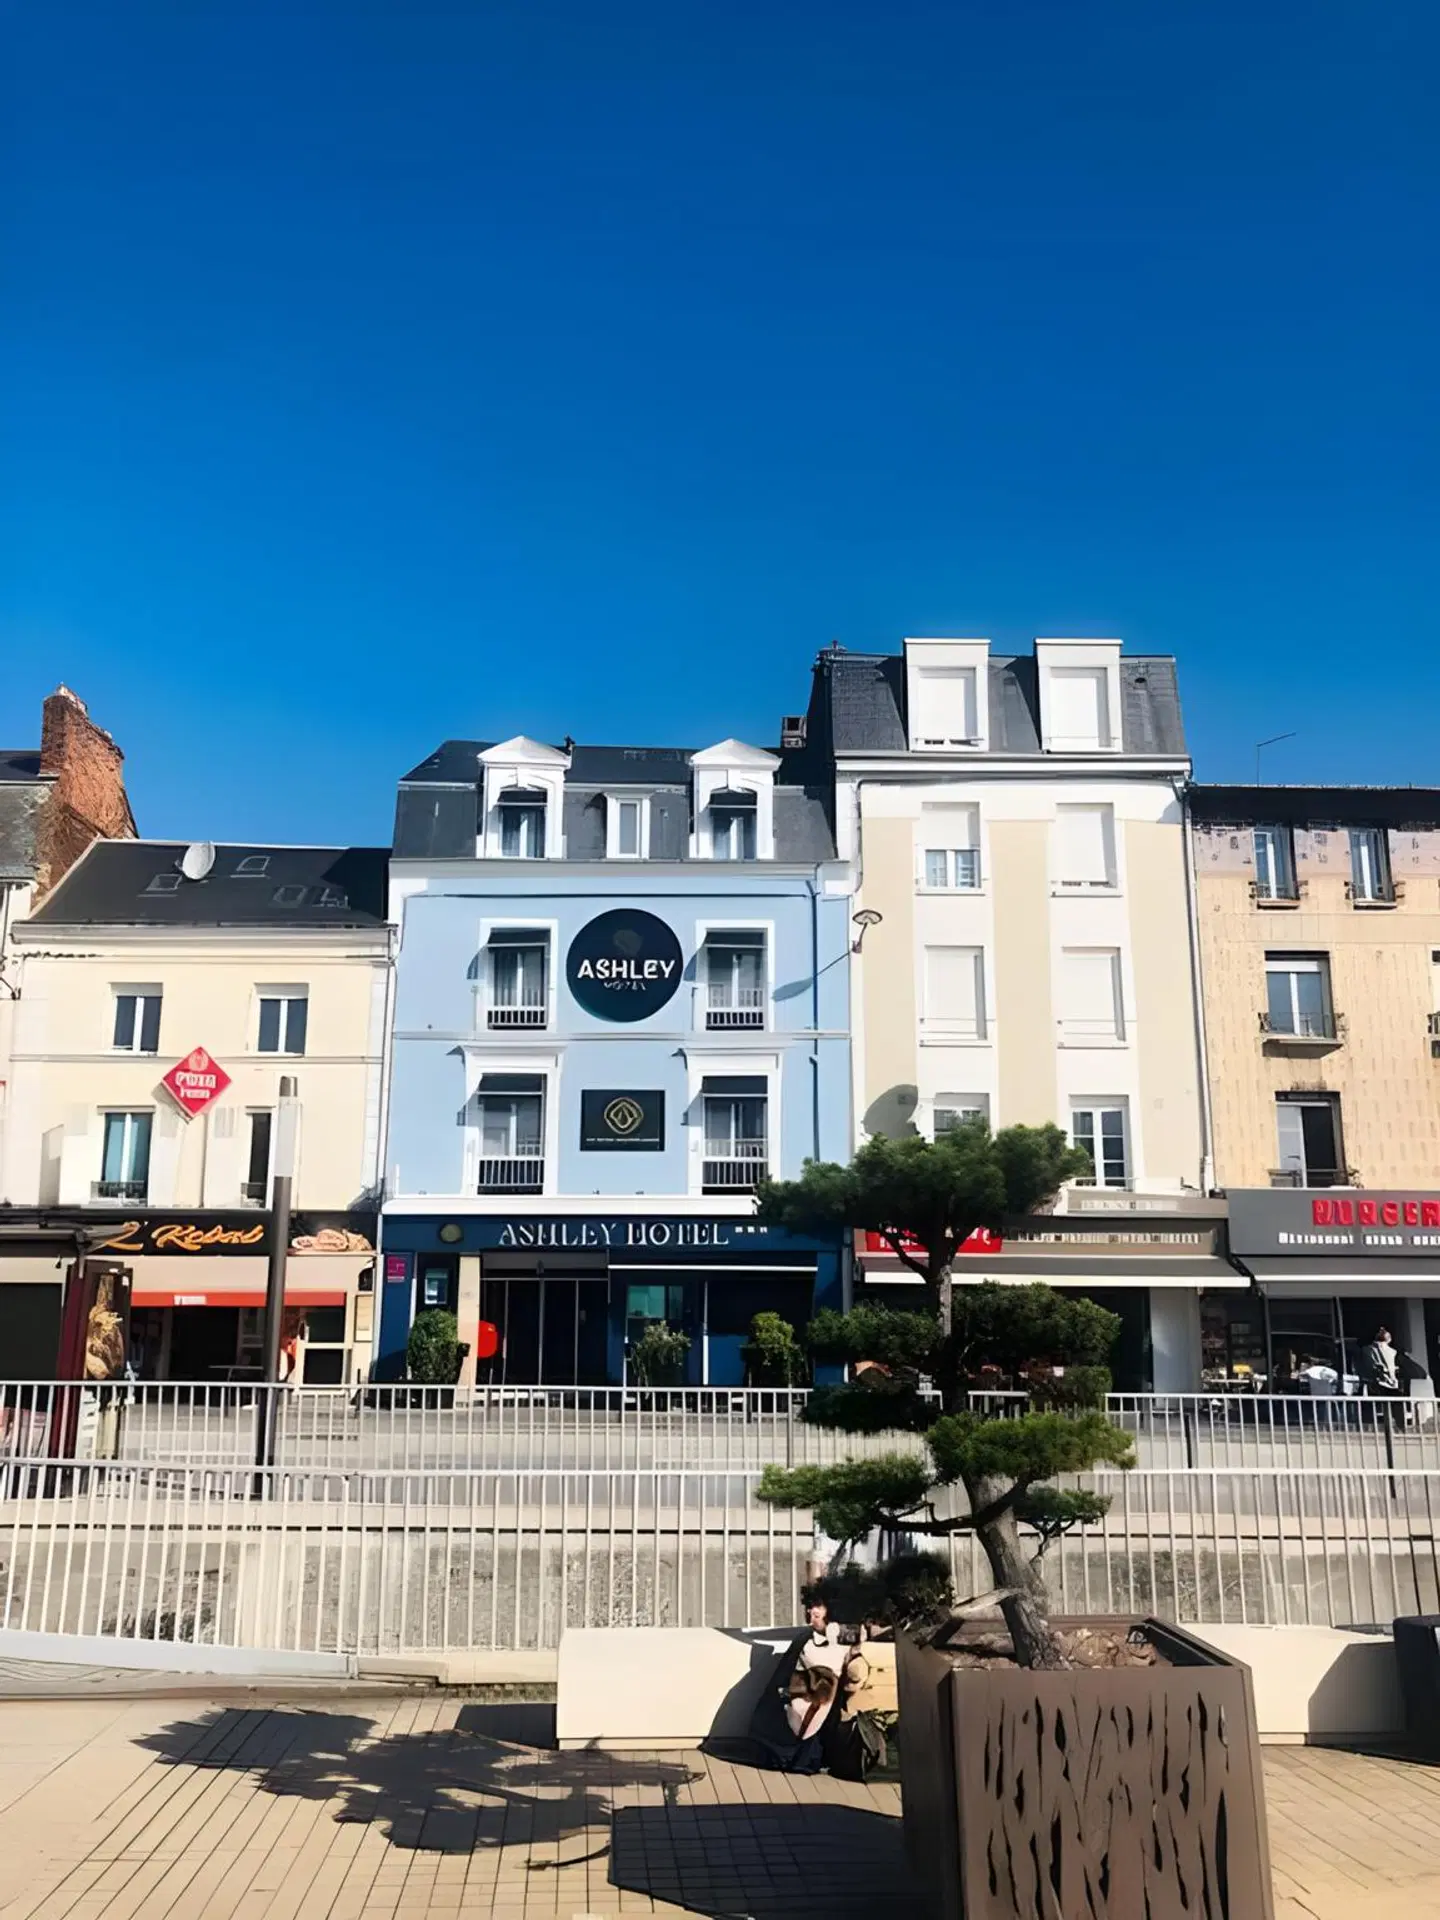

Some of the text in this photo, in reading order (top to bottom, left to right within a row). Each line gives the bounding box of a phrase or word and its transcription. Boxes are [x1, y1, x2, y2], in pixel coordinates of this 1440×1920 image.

[577, 958, 675, 979] ASHLEY
[498, 1223, 730, 1247] ASHLEY HOTEL
